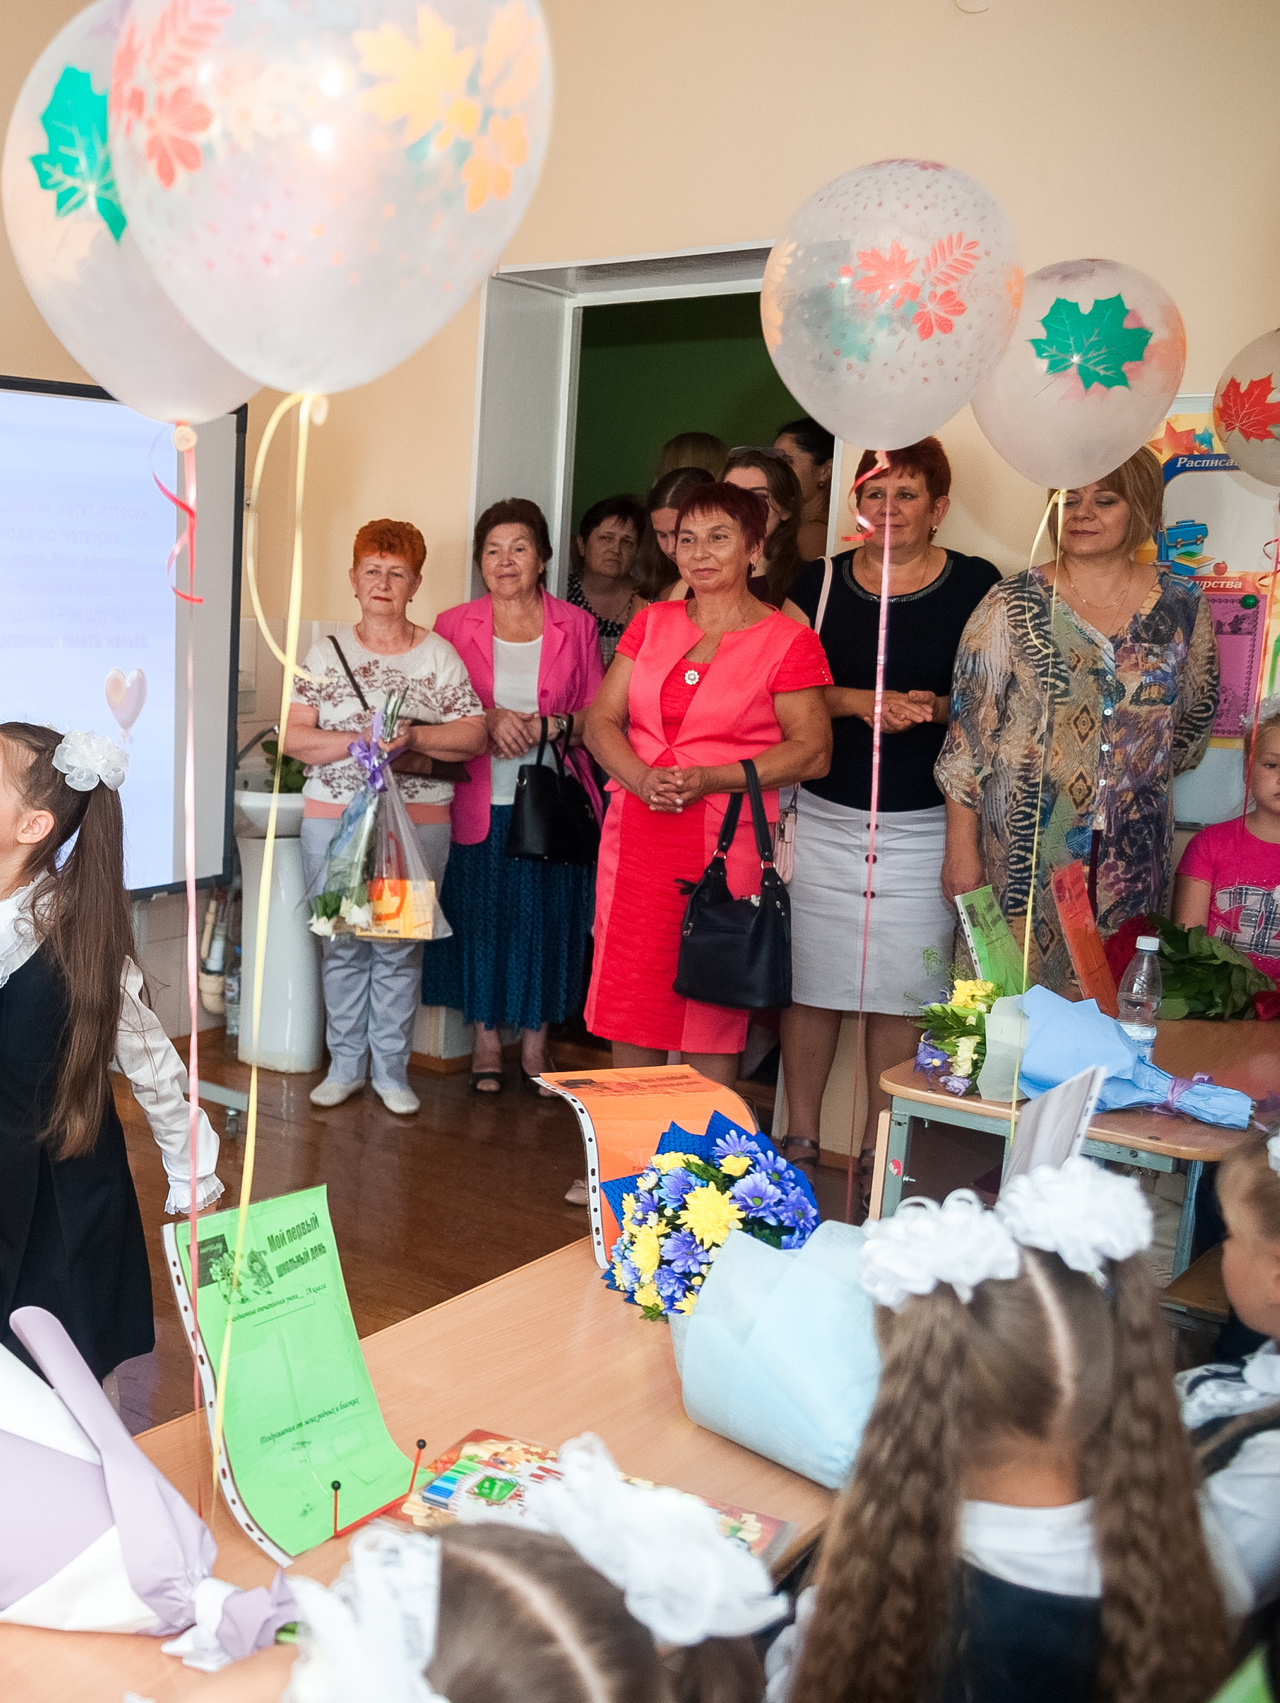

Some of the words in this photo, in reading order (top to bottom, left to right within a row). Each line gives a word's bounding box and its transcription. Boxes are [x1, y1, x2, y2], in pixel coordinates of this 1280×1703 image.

[1198, 580, 1242, 592] урства
[267, 1228, 288, 1254] Мой
[287, 1212, 319, 1242] первый
[275, 1248, 310, 1279] школьный
[309, 1243, 327, 1264] день
